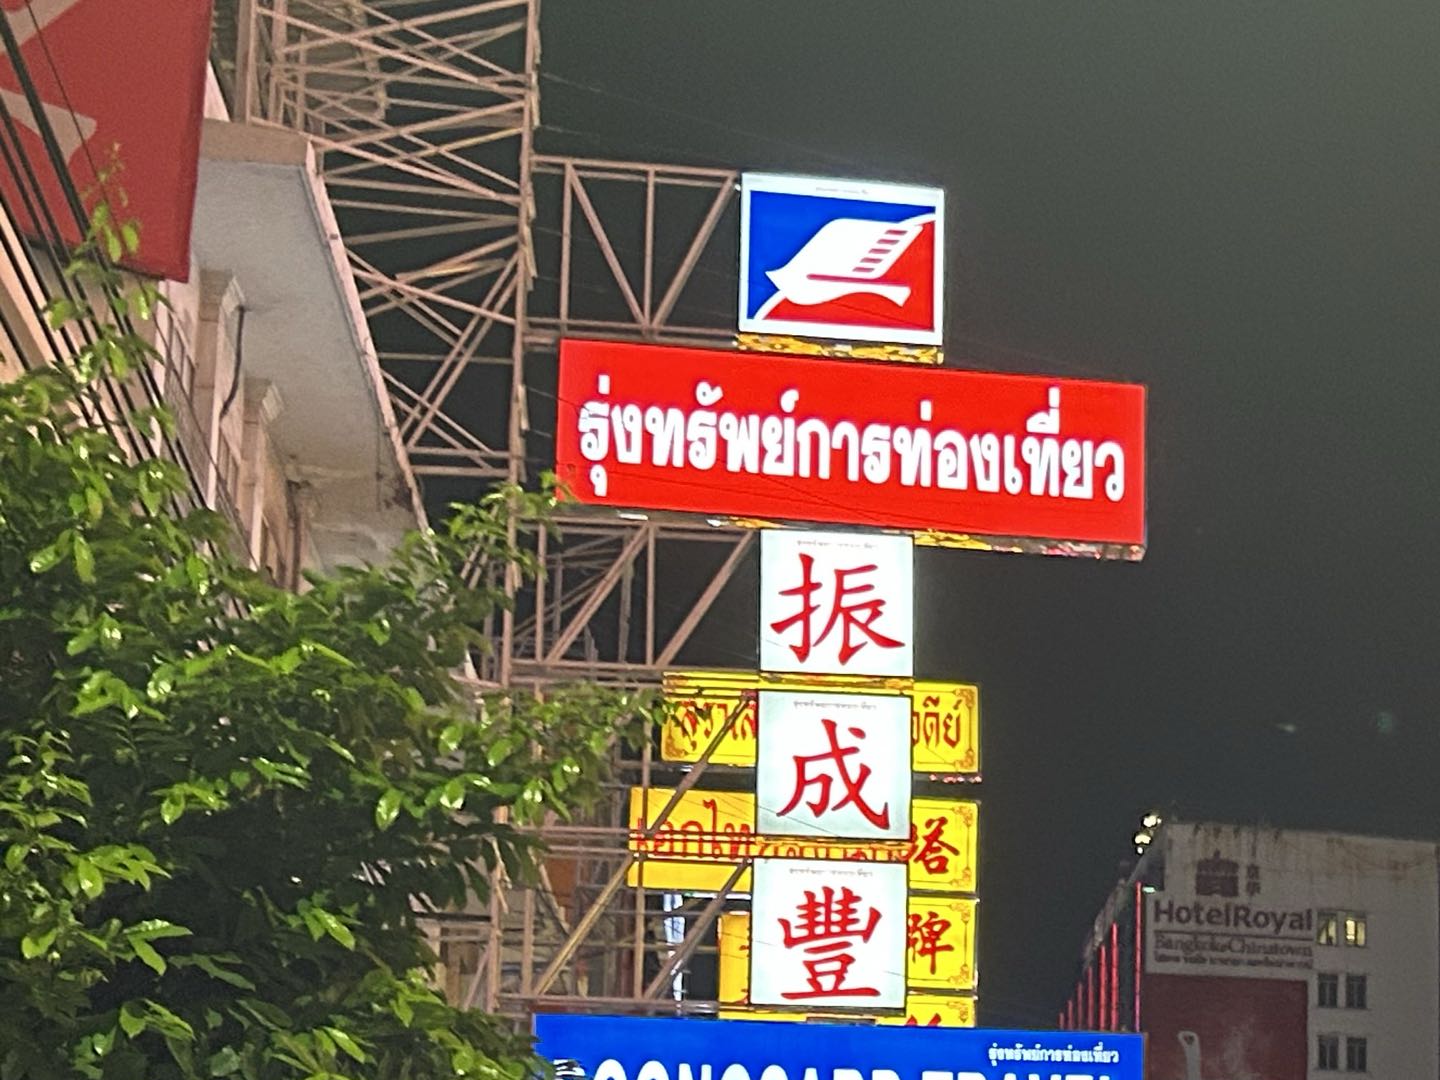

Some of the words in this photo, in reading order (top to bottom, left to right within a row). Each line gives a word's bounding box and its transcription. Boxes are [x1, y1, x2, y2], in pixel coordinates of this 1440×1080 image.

[578, 373, 1126, 502] รุ่งทรัพย์การท่องเที่ยว
